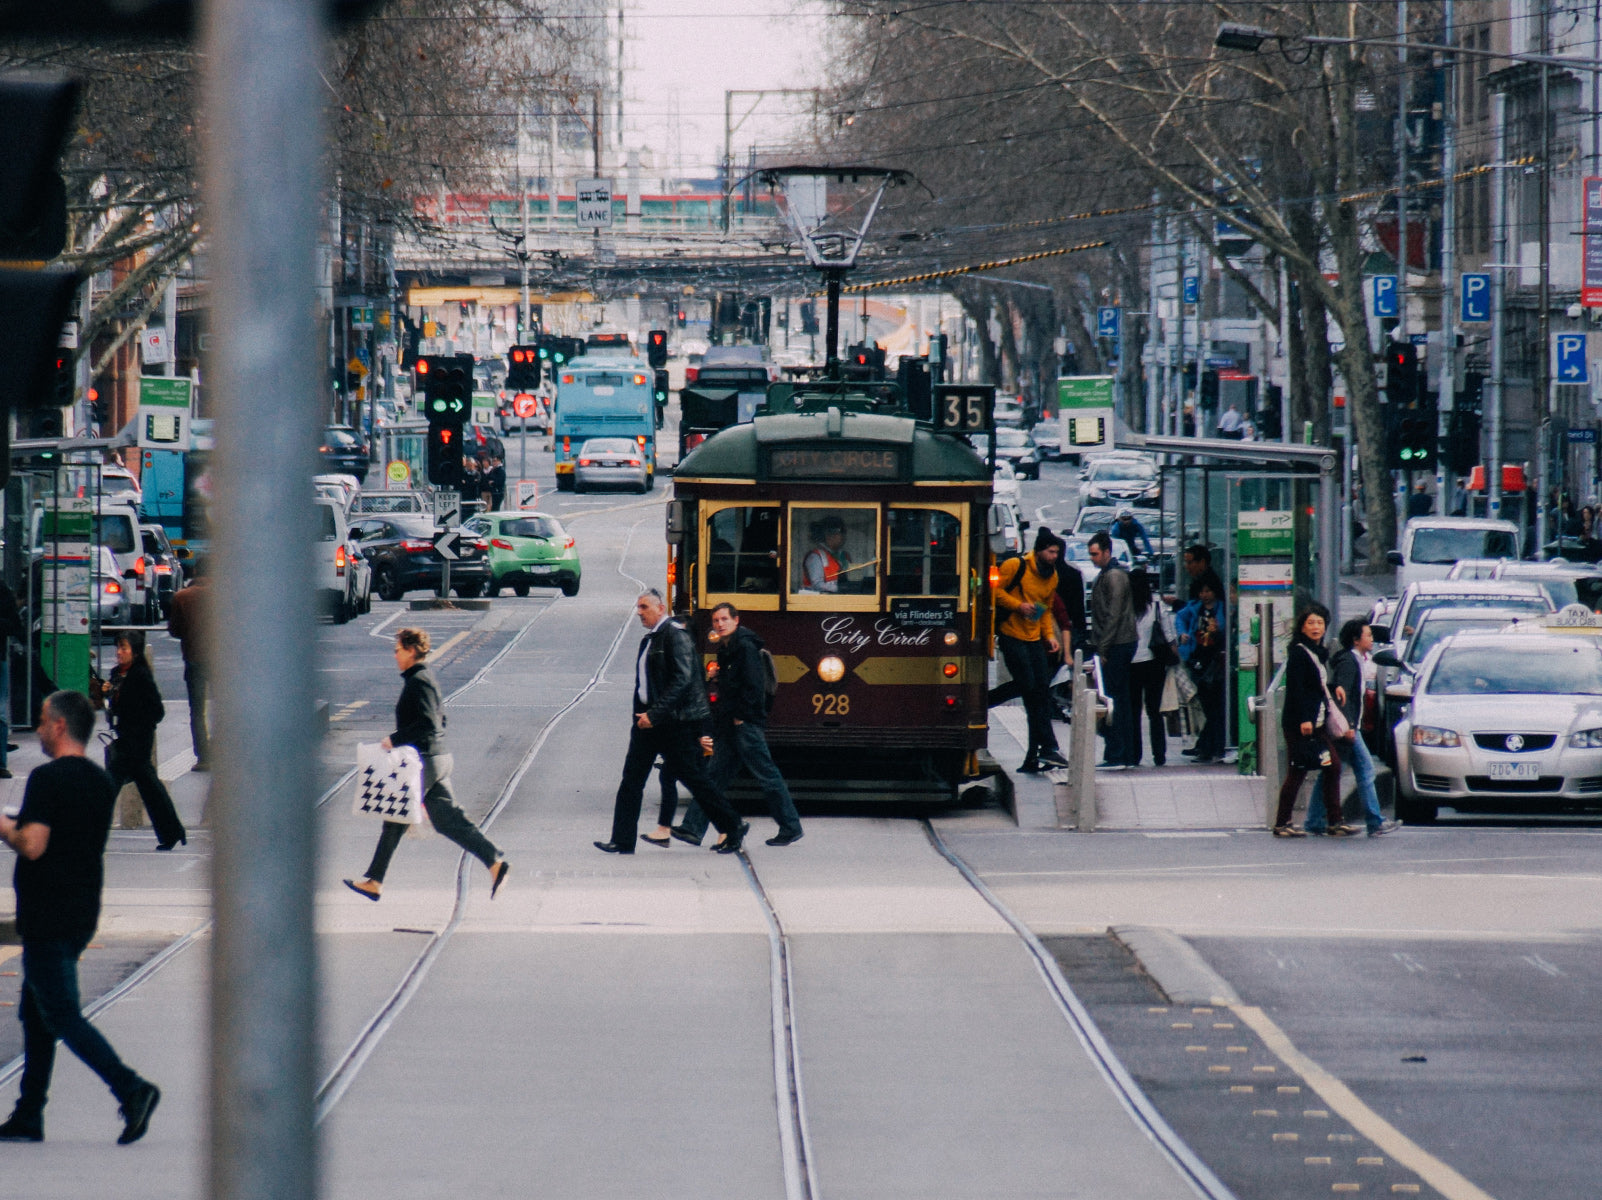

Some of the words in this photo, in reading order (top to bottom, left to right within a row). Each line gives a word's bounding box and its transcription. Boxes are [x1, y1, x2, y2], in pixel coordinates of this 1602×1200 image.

[580, 210, 608, 221] LANE
[1377, 278, 1392, 297] P
[1468, 277, 1485, 298] P
[1102, 309, 1115, 325] P
[1563, 337, 1582, 360] P
[943, 395, 982, 427] 35
[830, 451, 894, 469] CIRCLE
[894, 611, 908, 620] via
[909, 610, 943, 620] Flinders
[943, 610, 953, 620] St
[1567, 610, 1589, 618] TAXI
[820, 616, 871, 653] City
[874, 617, 933, 646] Circle
[811, 693, 850, 715] 928
